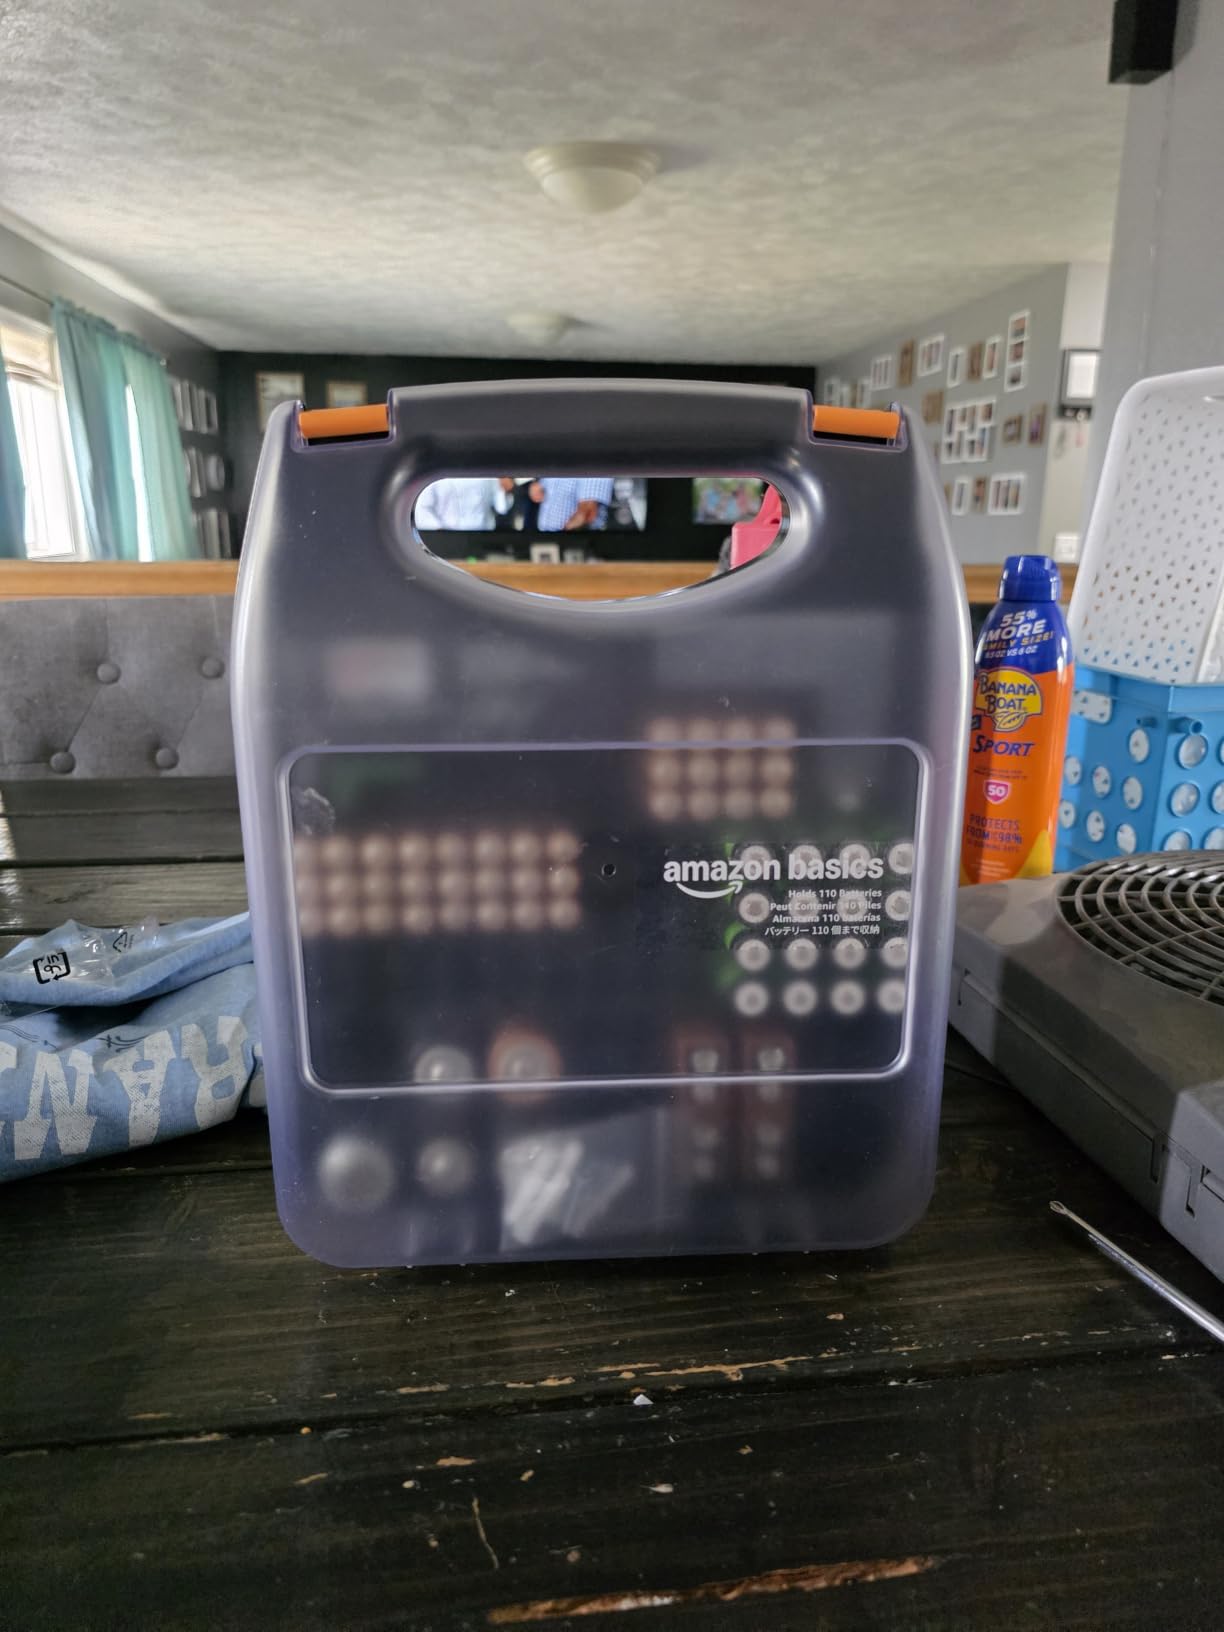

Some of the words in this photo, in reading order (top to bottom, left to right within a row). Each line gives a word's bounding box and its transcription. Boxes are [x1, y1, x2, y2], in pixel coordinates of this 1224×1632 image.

[1000, 609, 1037, 627] 55%
[987, 620, 1046, 641] MORE
[980, 672, 1036, 695] BANANA
[985, 695, 1025, 714] BOAT
[973, 735, 1035, 756] SPORT
[988, 784, 1006, 797] 50
[663, 859, 781, 883] amazon
[788, 853, 884, 880] basics
[788, 889, 817, 898] Holds
[819, 888, 837, 898] 110
[770, 902, 792, 911] Peut
[822, 913, 840, 923] 110
[811, 926, 829, 935] 110
